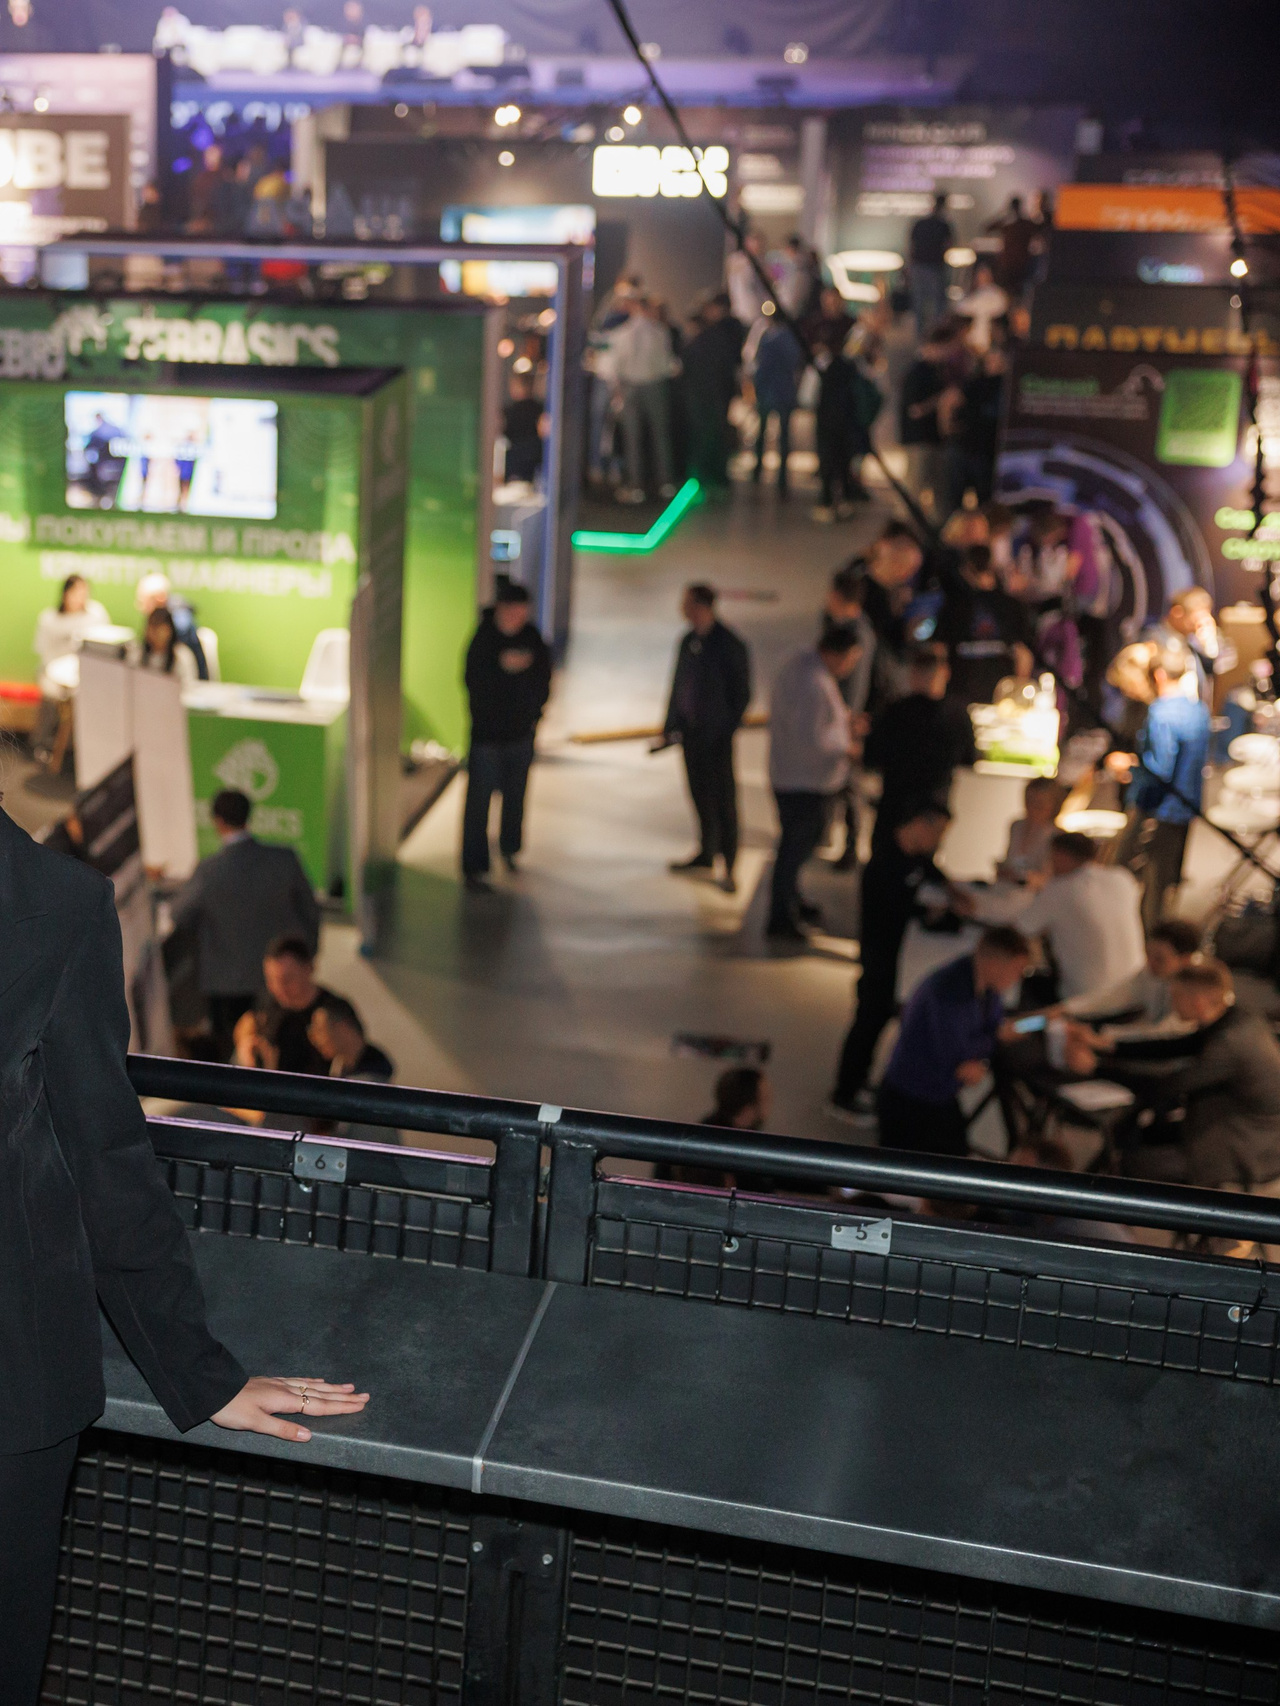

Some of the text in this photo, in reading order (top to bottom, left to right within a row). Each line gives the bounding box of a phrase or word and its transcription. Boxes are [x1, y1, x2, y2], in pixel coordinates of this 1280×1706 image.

[35, 515, 208, 553] ПОКУПАЕМ
[315, 1153, 326, 1170] 6
[855, 1225, 868, 1241] 5
